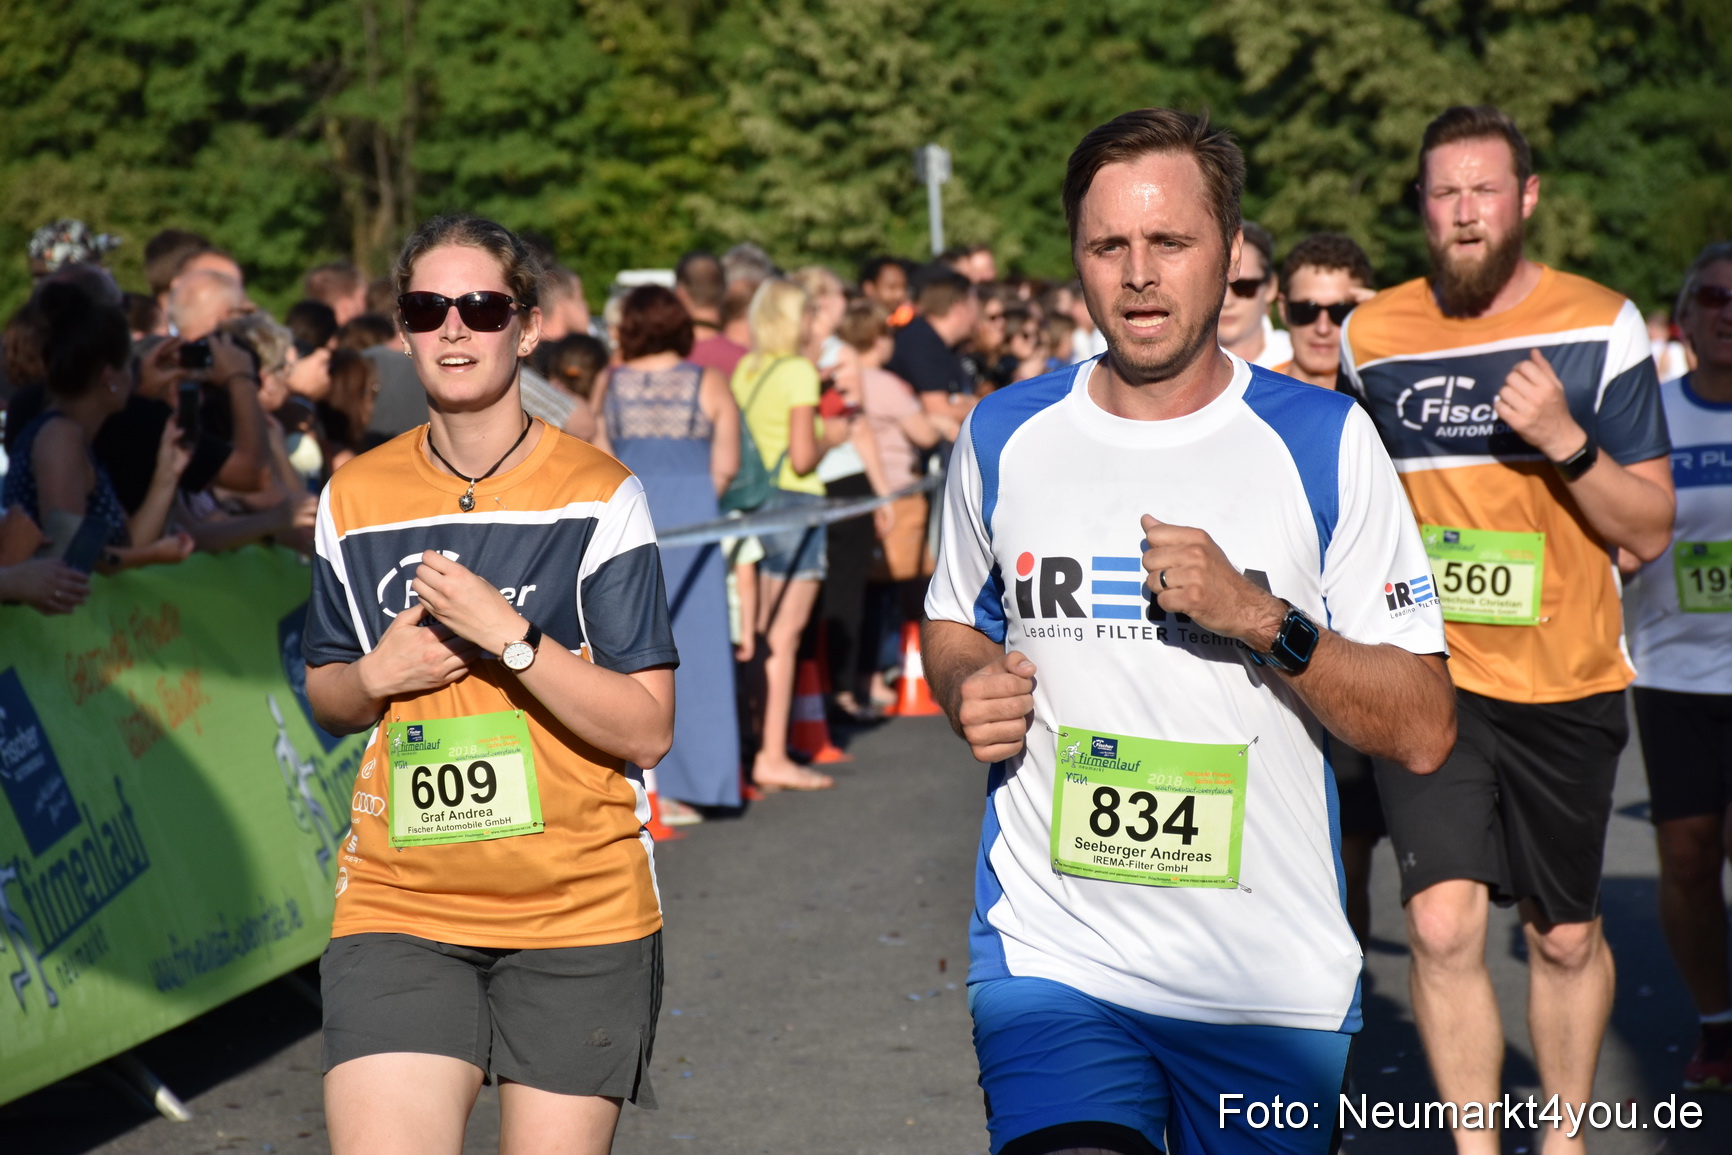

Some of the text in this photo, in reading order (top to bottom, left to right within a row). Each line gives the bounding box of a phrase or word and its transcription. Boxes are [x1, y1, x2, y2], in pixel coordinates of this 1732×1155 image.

[1443, 562, 1511, 596] 560
[1023, 624, 1084, 642] Leading
[1096, 624, 1169, 642] FILTER
[401, 739, 441, 752] firmenlauf
[448, 745, 477, 757] 2018
[1079, 752, 1141, 772] firmenlauf
[411, 760, 497, 810] 609
[1147, 773, 1183, 787] 2018
[421, 808, 493, 823] Graf Andrea
[1089, 786, 1199, 846] 834
[407, 825, 433, 834] Fischer
[436, 821, 483, 832] Automobile
[485, 816, 512, 827] GmbH
[1074, 836, 1212, 862] Seeberger Andreas
[14, 775, 151, 962] firmenlauf
[1093, 855, 1154, 870] IREMA-Filter
[1157, 862, 1188, 873] GmbH
